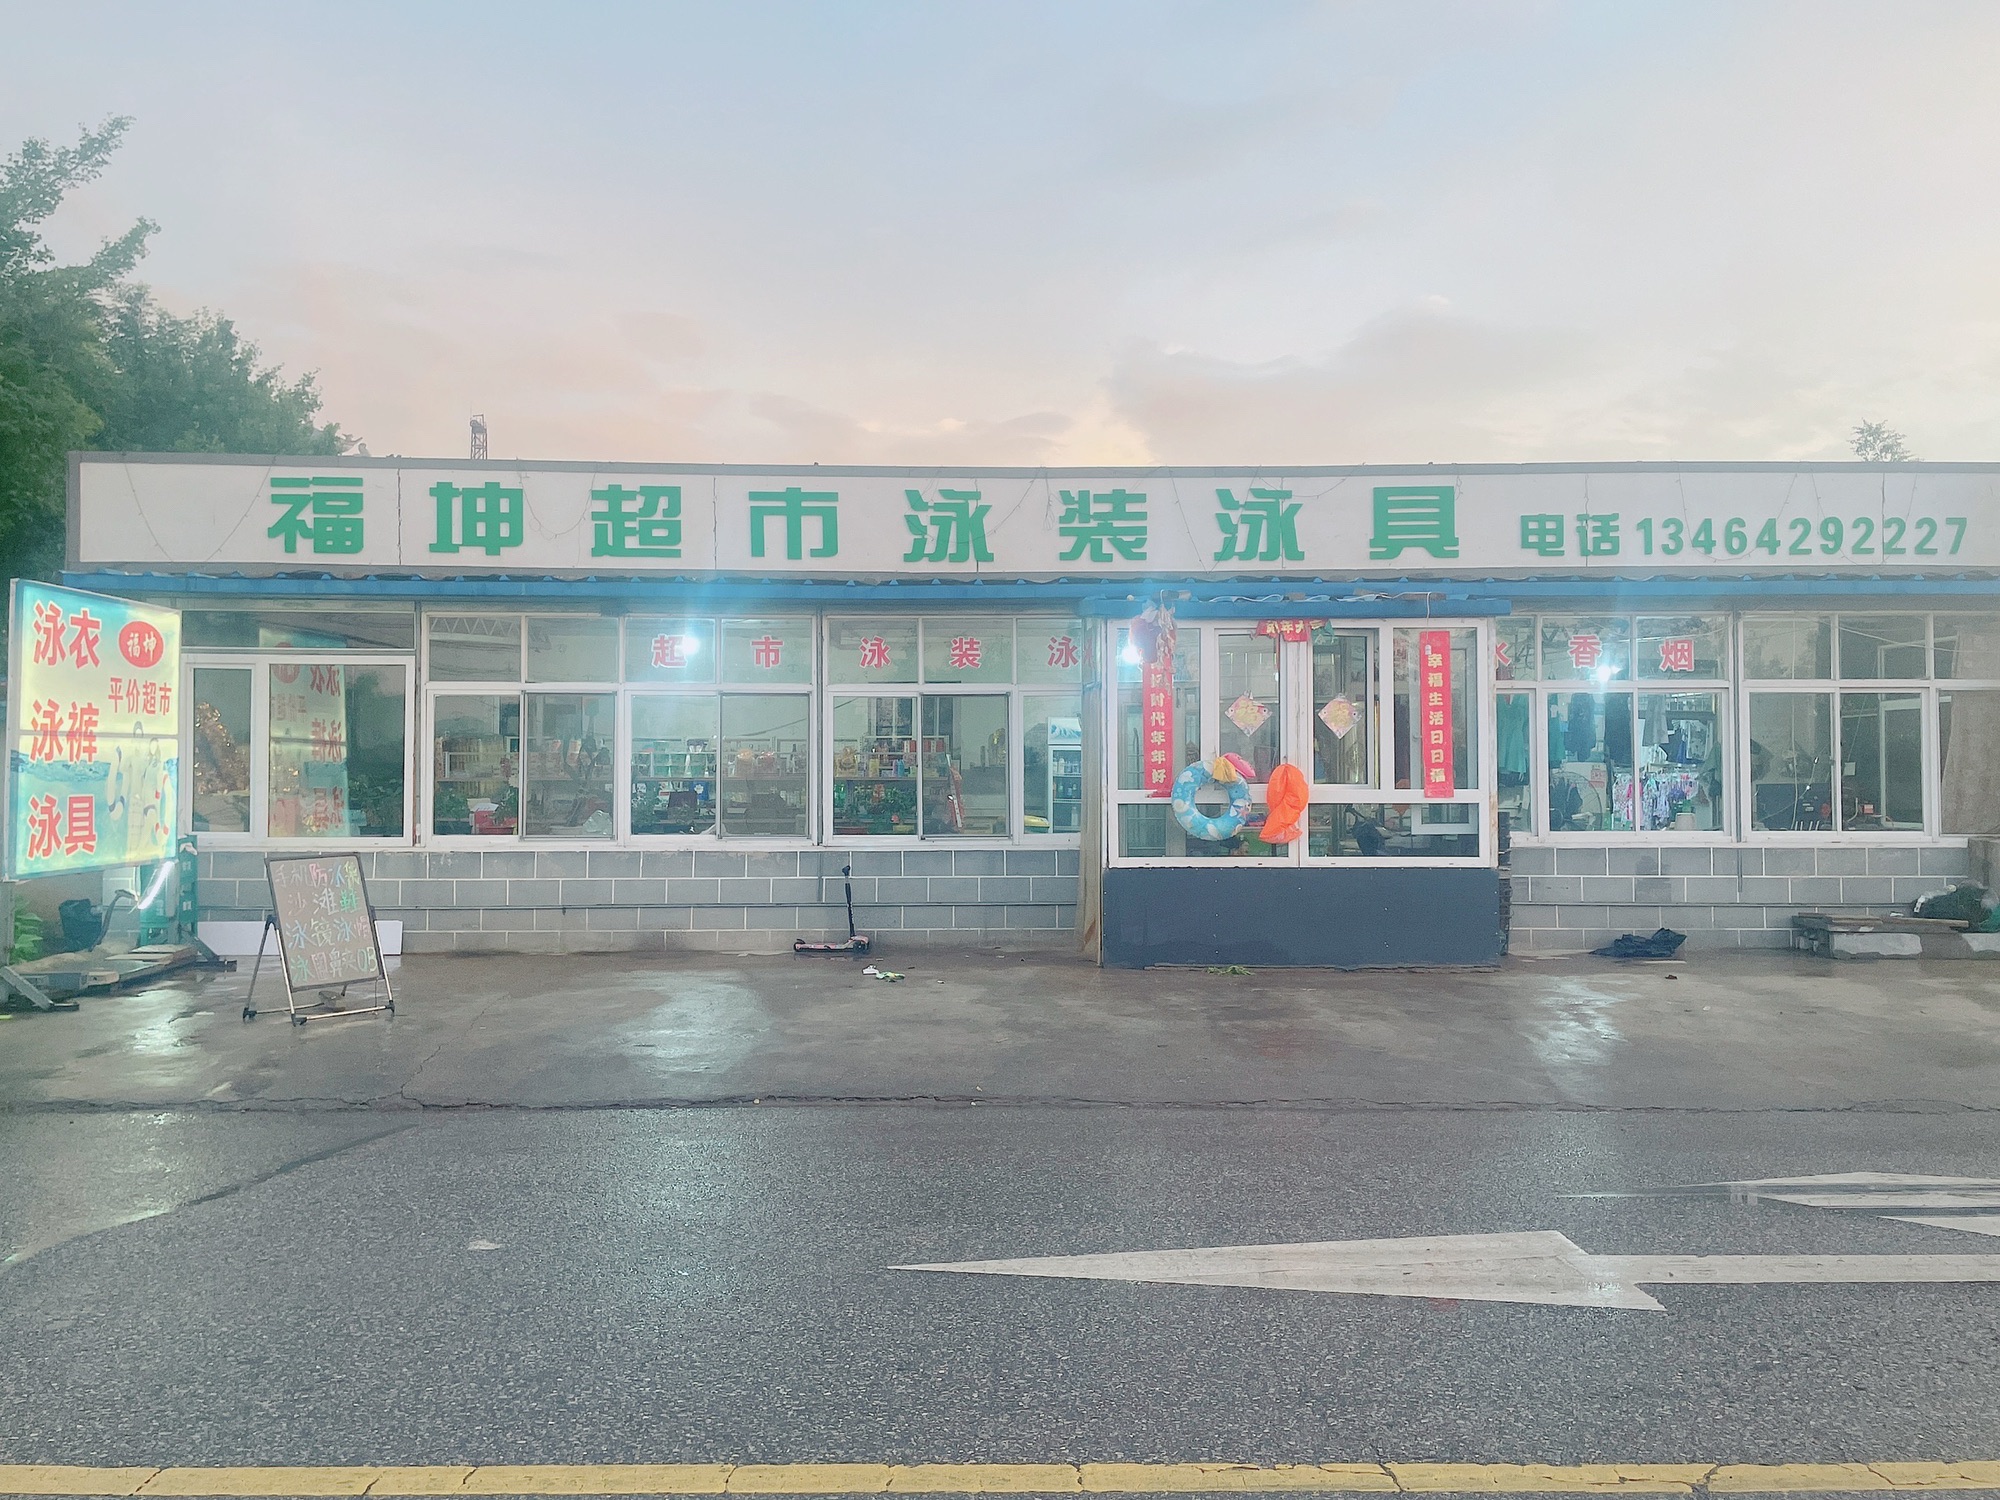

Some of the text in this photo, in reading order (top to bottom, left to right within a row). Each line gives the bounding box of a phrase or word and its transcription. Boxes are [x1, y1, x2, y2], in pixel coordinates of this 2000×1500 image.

[267, 476, 1459, 563] 福坤超市泳装泳具
[1520, 513, 1968, 557] 电话 13464292227
[33, 600, 101, 668] 泳衣
[126, 631, 157, 662] 福坤
[108, 677, 172, 716] 平价超市
[1150, 661, 1167, 785] 时代年年好
[1427, 653, 1446, 783] 幸福生活日日福
[30, 699, 99, 763] 泳裤
[27, 794, 97, 859] 泳具
[288, 888, 359, 916] 沙滩鞋
